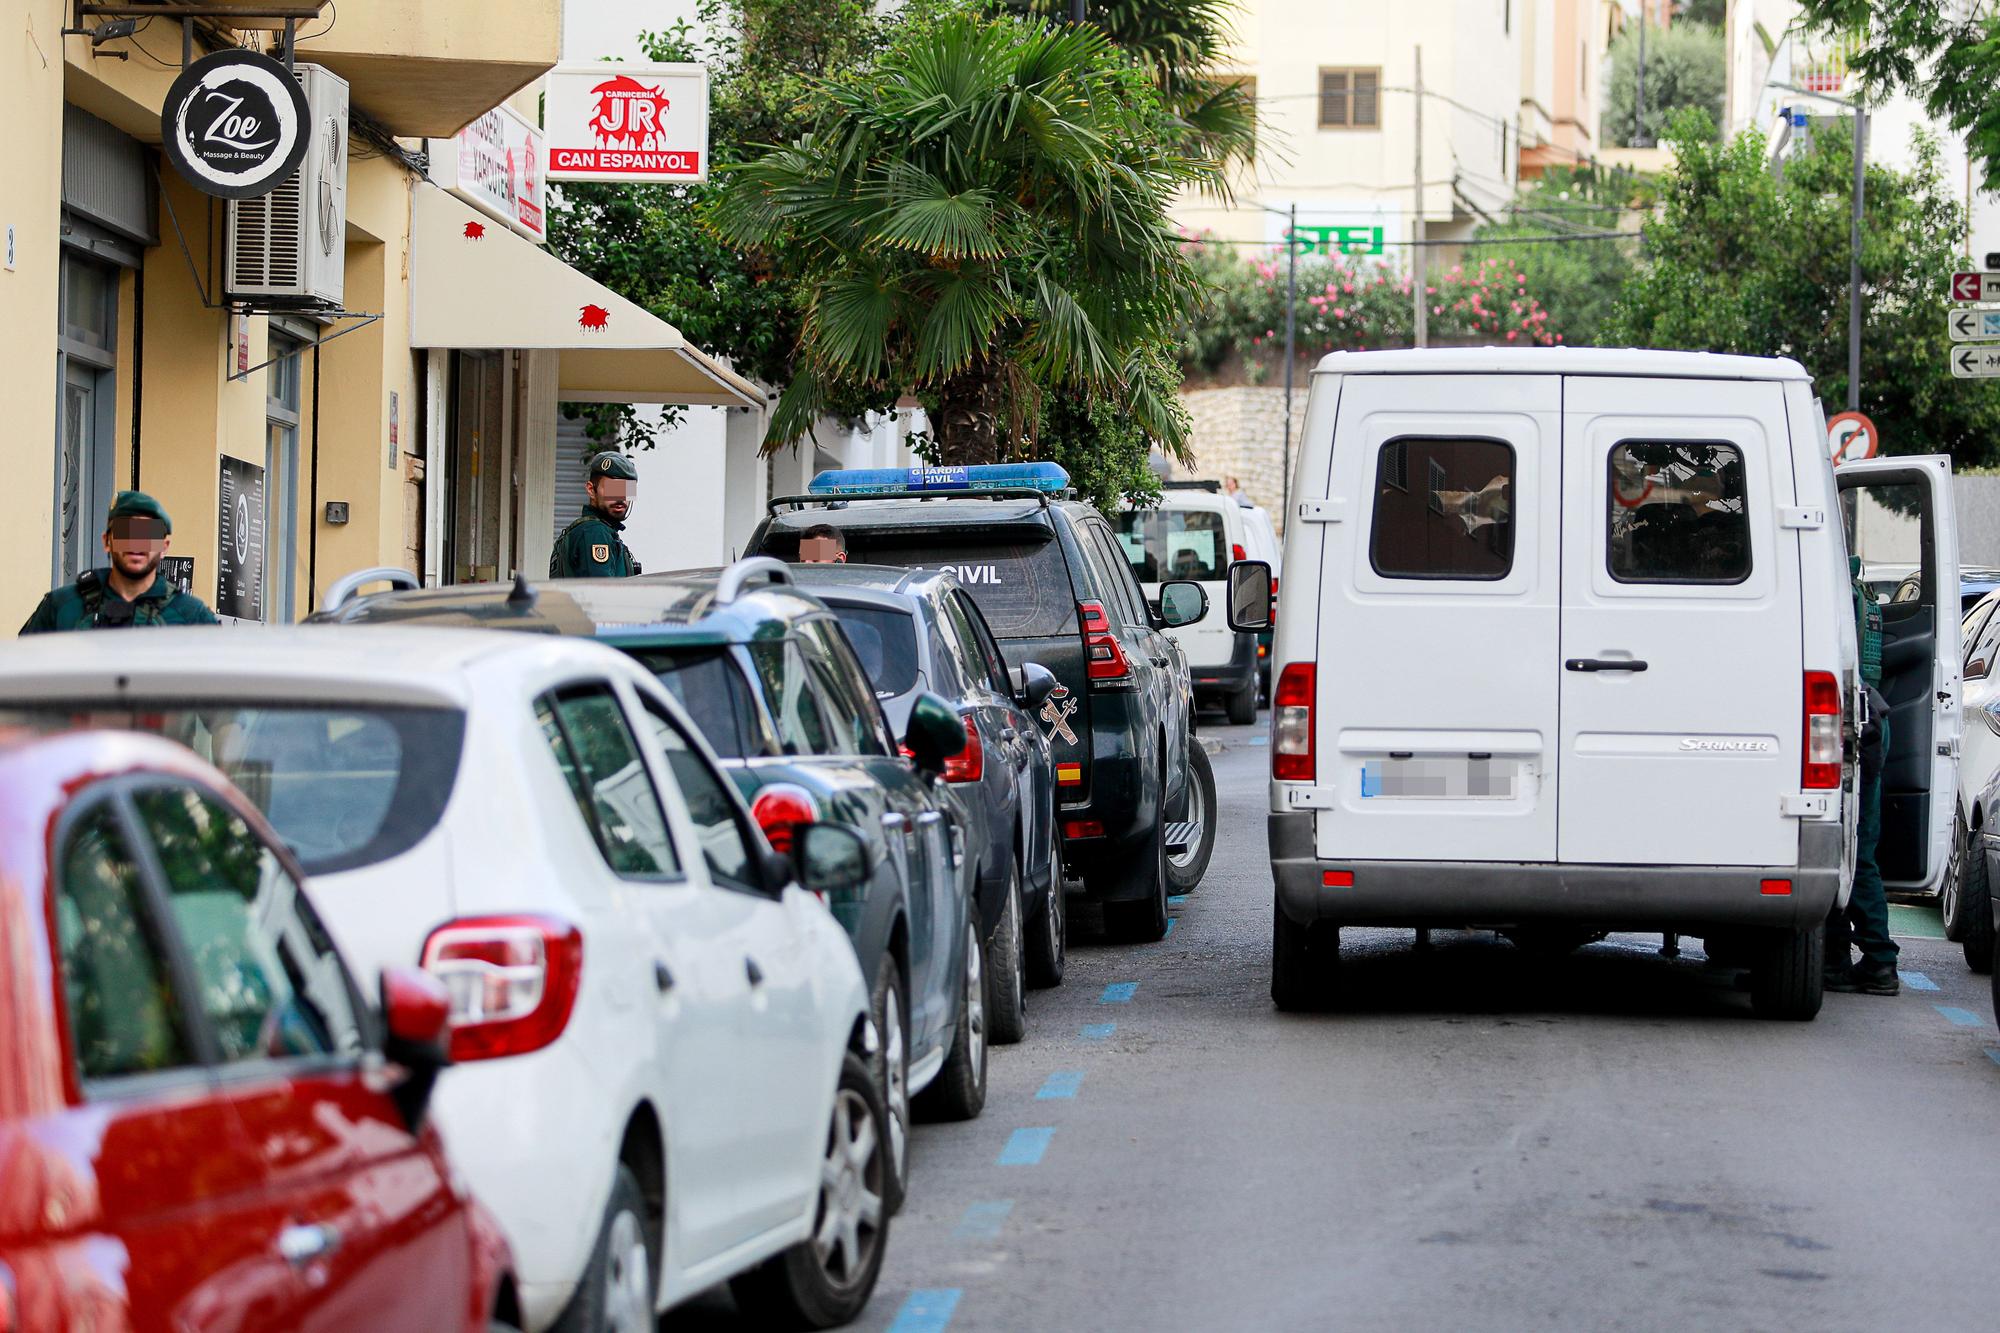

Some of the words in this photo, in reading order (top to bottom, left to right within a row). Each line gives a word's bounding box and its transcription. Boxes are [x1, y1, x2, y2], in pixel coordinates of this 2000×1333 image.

[605, 90, 657, 99] CARNICERÍA
[204, 92, 275, 150] Zoe
[600, 98, 657, 132] JR
[203, 151, 233, 160] Massage
[240, 152, 265, 161] Beauty
[557, 152, 595, 167] CAN
[600, 153, 691, 170] ESPANYOL
[911, 467, 965, 476] GUARDIA
[924, 474, 954, 484] CIVIL
[1679, 738, 1768, 752] SPRINTER
